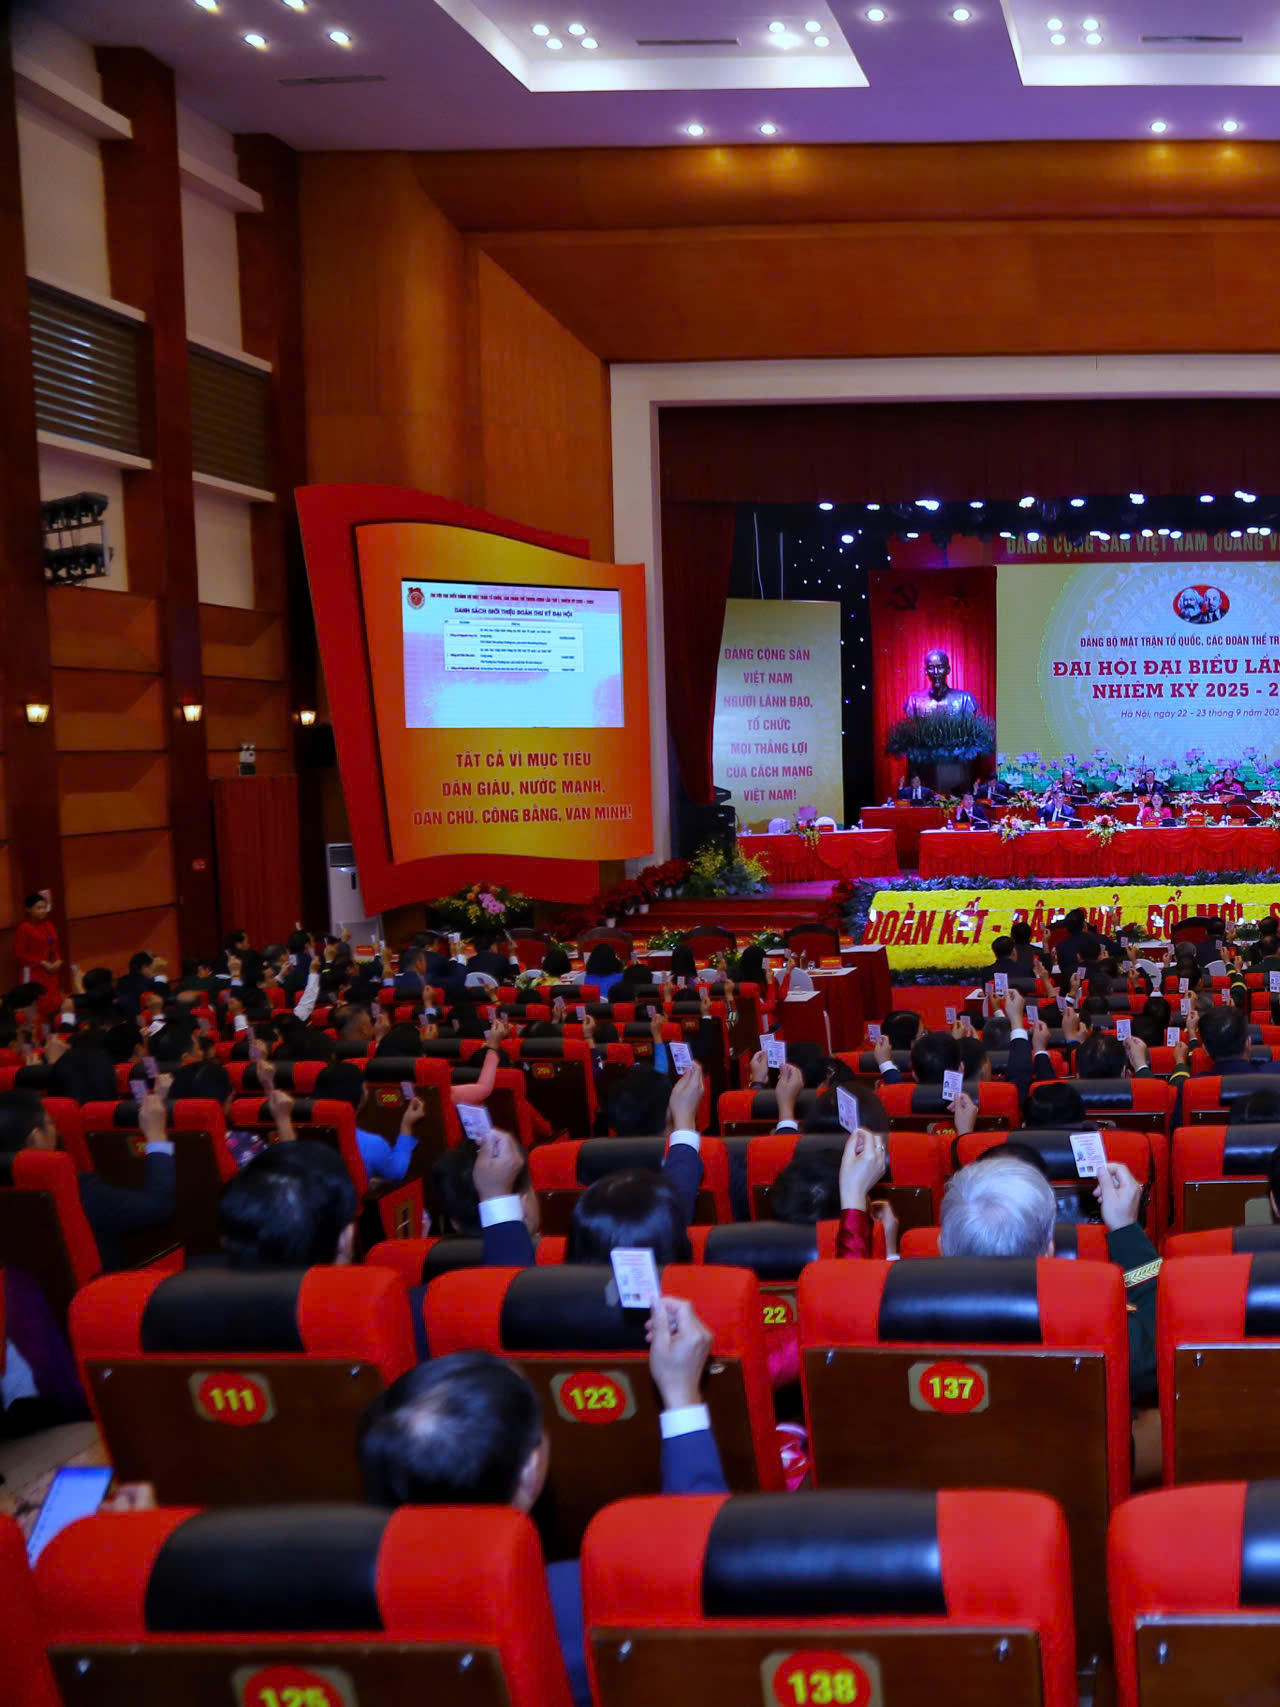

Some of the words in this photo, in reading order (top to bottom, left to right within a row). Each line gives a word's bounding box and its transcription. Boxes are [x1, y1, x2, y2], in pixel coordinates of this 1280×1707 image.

[1173, 533, 1209, 552] NAM
[1080, 634, 1104, 648] ĐẢNG
[1106, 635, 1118, 648] BỘ
[1120, 634, 1139, 649] MẶT
[1141, 634, 1164, 648] TRẬN
[1166, 631, 1176, 647] TỔ
[1178, 632, 1204, 647] QUỐC,
[1206, 633, 1223, 646] CÁC
[1225, 632, 1249, 646] ĐOÀN
[1251, 631, 1267, 646] THỂ
[743, 670, 766, 686] VIỆT
[768, 672, 793, 684] NAM
[1053, 660, 1092, 680] ĐẠI
[1098, 657, 1137, 679] HỘI
[1143, 659, 1182, 678] ĐẠI
[1188, 653, 1239, 675] BIỂU
[1092, 680, 1164, 702] NHIỆM
[1169, 679, 1199, 698] KỲ
[1205, 682, 1250, 698] 2025
[455, 749, 481, 769] TẤT
[485, 748, 505, 768] CẢ
[509, 750, 522, 767] VÌ
[527, 752, 559, 770] MỤC
[743, 787, 766, 804] VIỆT
[768, 788, 797, 801] NAM!
[861, 902, 937, 946] ĐOÀN
[937, 896, 990, 945] KẾT
[762, 1305, 787, 1325] 22
[209, 1387, 254, 1412] 111
[568, 1385, 618, 1410] 123
[928, 1376, 974, 1400] 137
[787, 1670, 857, 1705] 138
